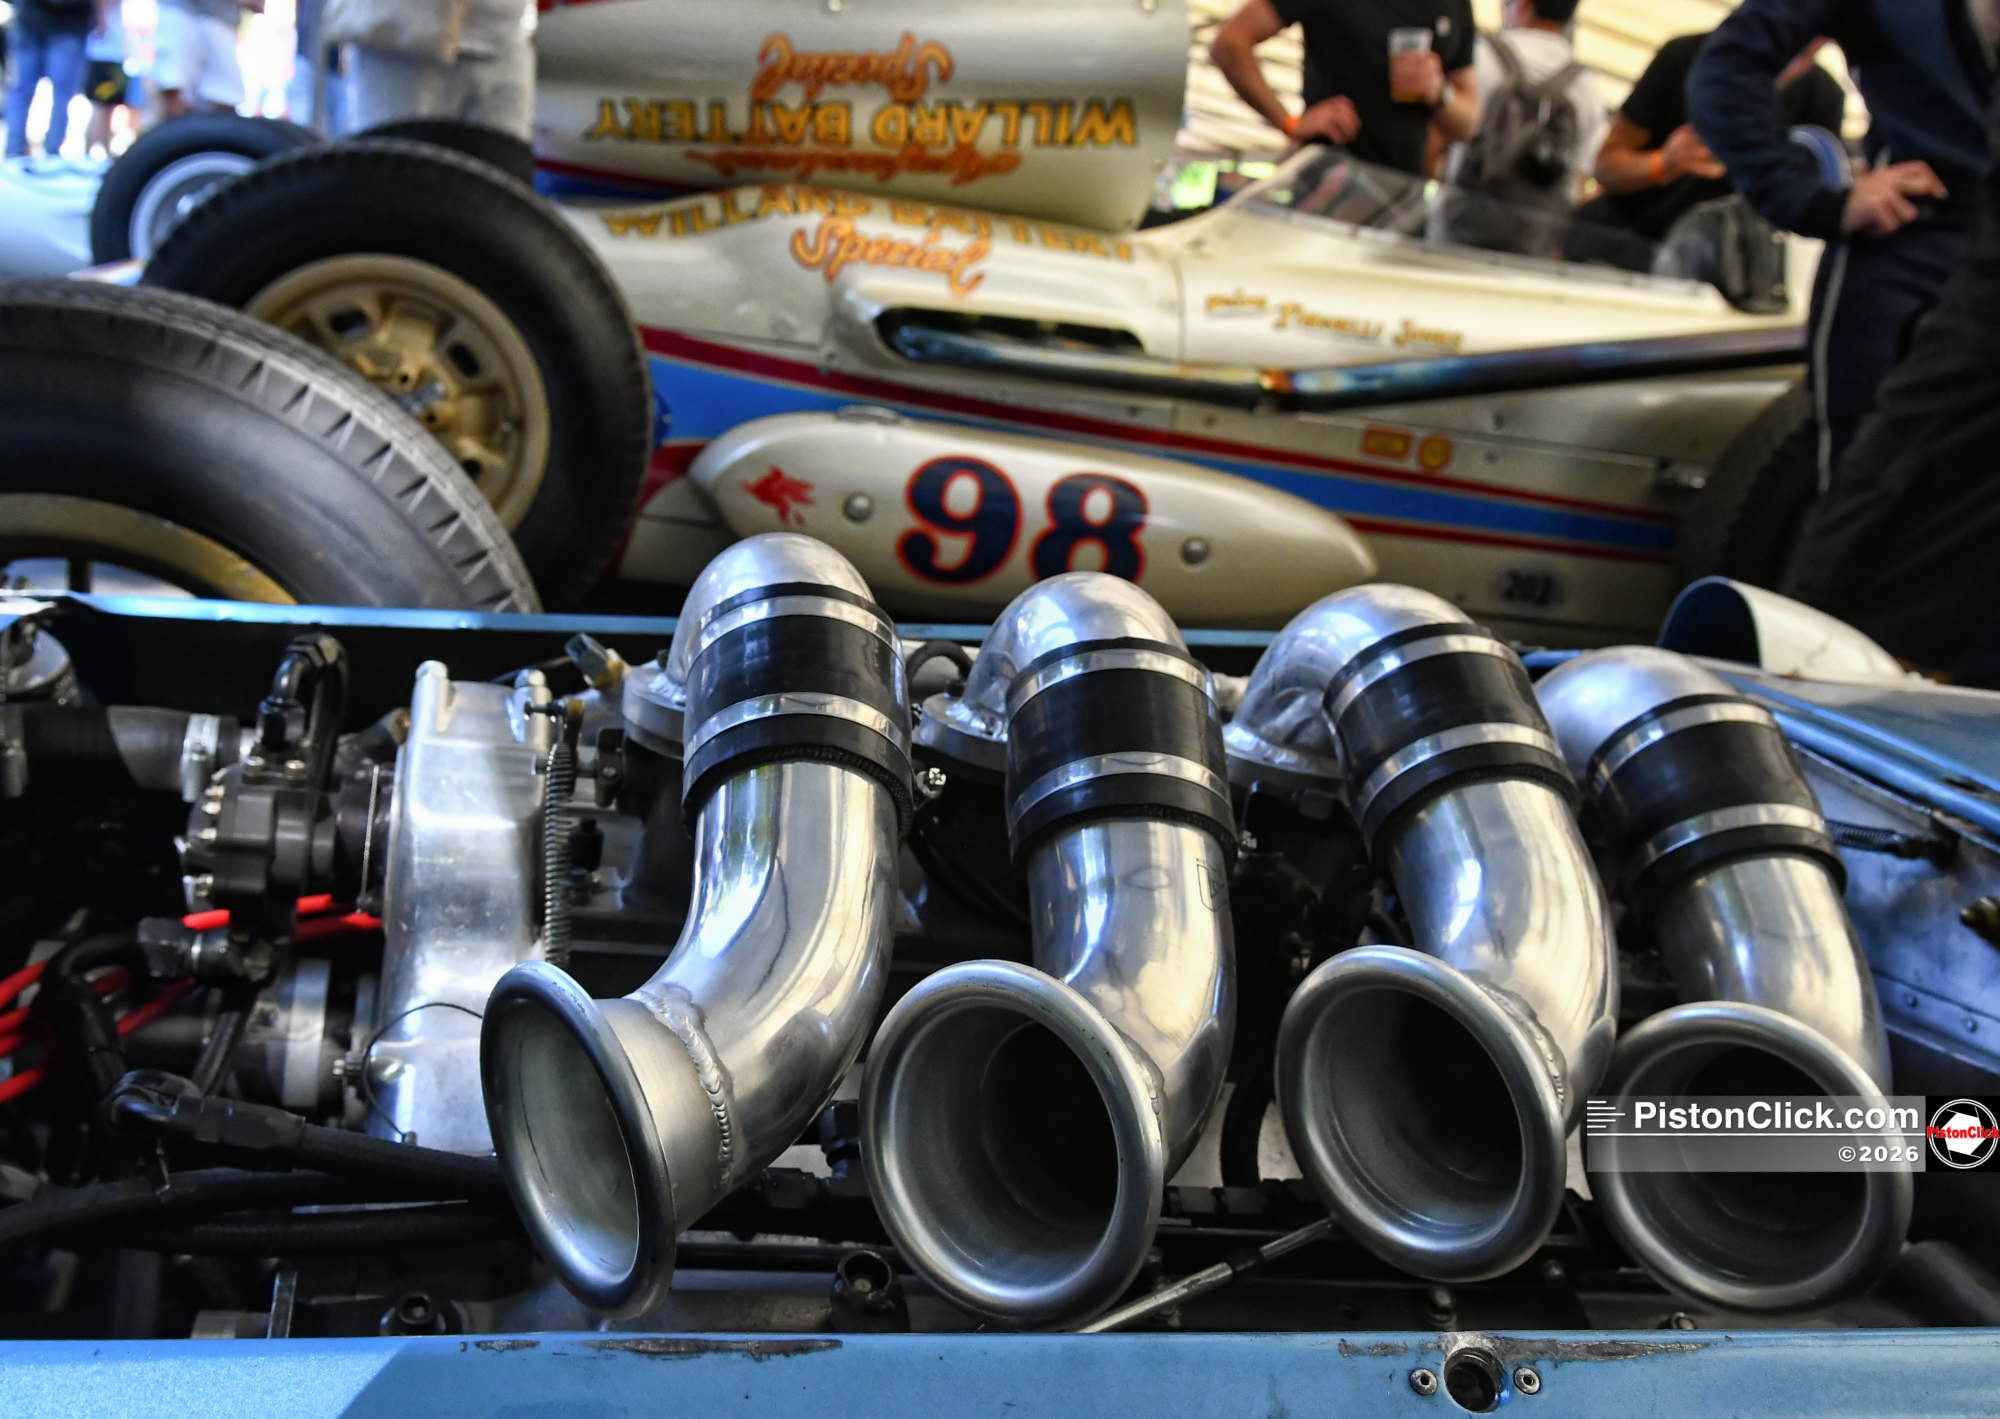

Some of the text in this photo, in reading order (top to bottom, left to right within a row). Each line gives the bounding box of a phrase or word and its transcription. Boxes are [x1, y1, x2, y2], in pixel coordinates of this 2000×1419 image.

[751, 29, 954, 104] Special
[586, 97, 1138, 147] WILLARD BATTERY
[790, 213, 992, 297] Special
[895, 454, 1148, 584] 98
